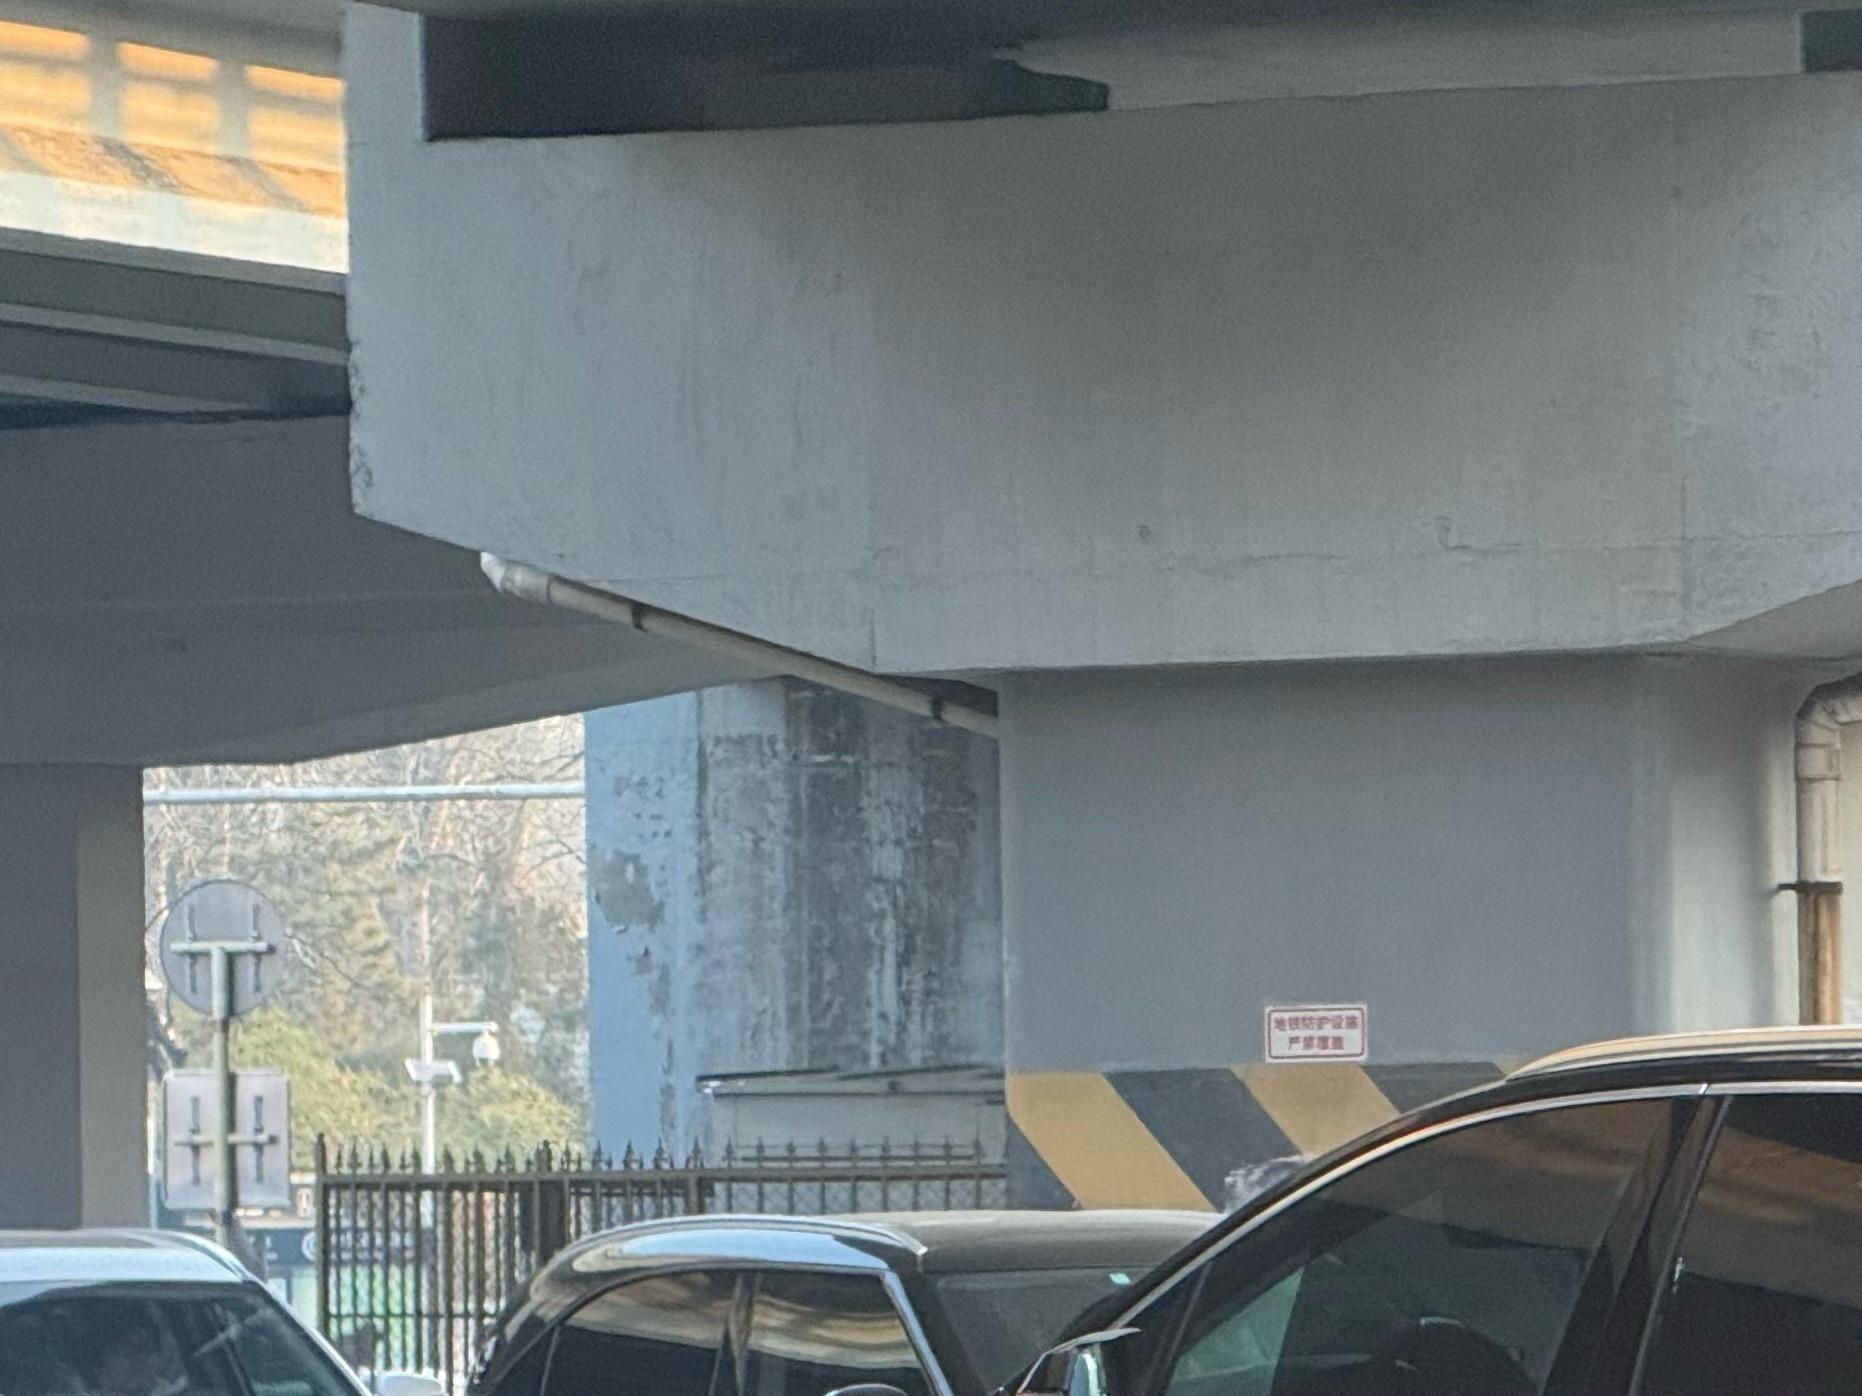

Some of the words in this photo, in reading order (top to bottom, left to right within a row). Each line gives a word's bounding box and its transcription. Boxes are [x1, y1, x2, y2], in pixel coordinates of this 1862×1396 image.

[1274, 1015, 1359, 1031] 地铁防护设施
